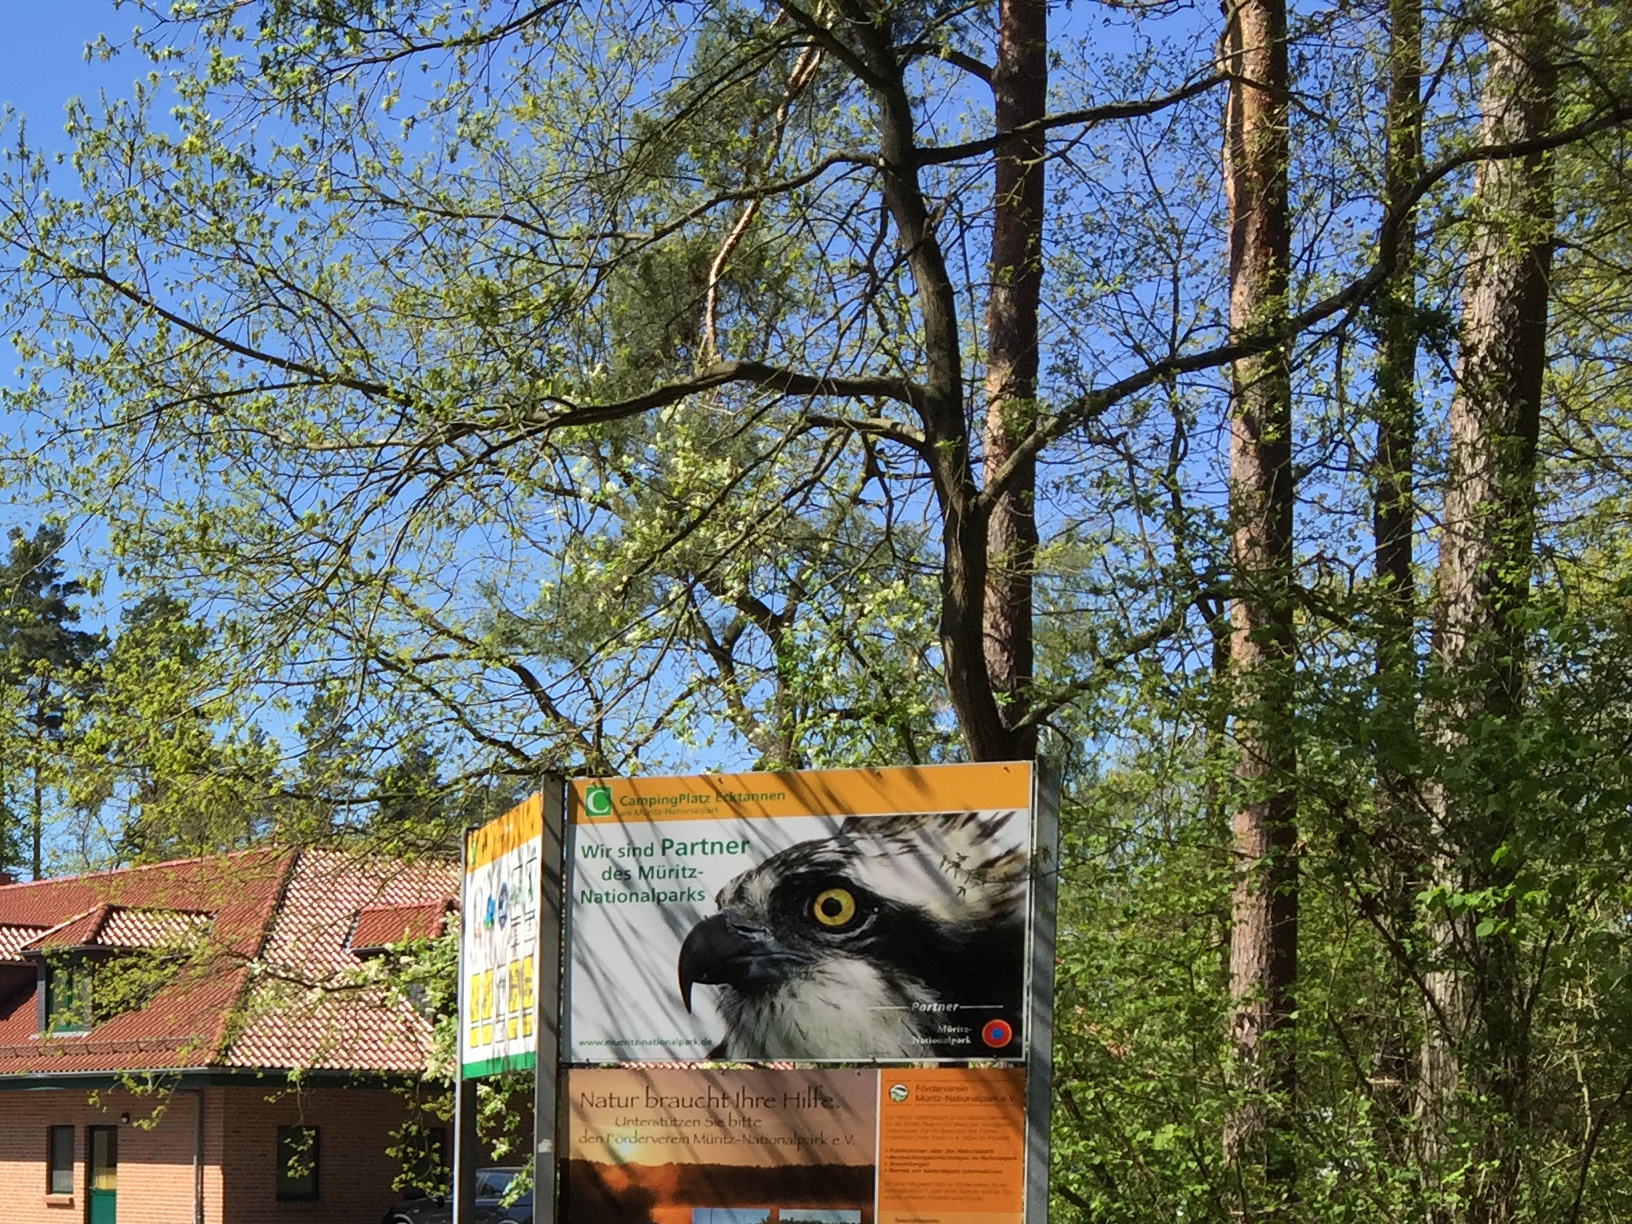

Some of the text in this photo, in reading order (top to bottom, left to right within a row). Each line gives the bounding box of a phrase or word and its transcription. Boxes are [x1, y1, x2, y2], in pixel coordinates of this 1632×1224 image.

[619, 790, 786, 807] CampingPlatz Ecktannen
[581, 837, 750, 859] Wir sind Partner
[601, 864, 704, 881] des Müritz-
[580, 886, 706, 905] Nationalparks
[911, 1000, 959, 1012] Partner
[578, 1037, 713, 1048] www.mueritz-nationalpark.de
[912, 1035, 972, 1046] Nationalpark
[580, 1085, 841, 1109] Natur braucht Ihre Hilfe.
[615, 1112, 763, 1128] Unterstützen Sie bitte
[578, 1129, 604, 1145] den
[606, 1130, 690, 1145] Förderverein
[693, 1131, 828, 1151] Müritz-Nationalpark
